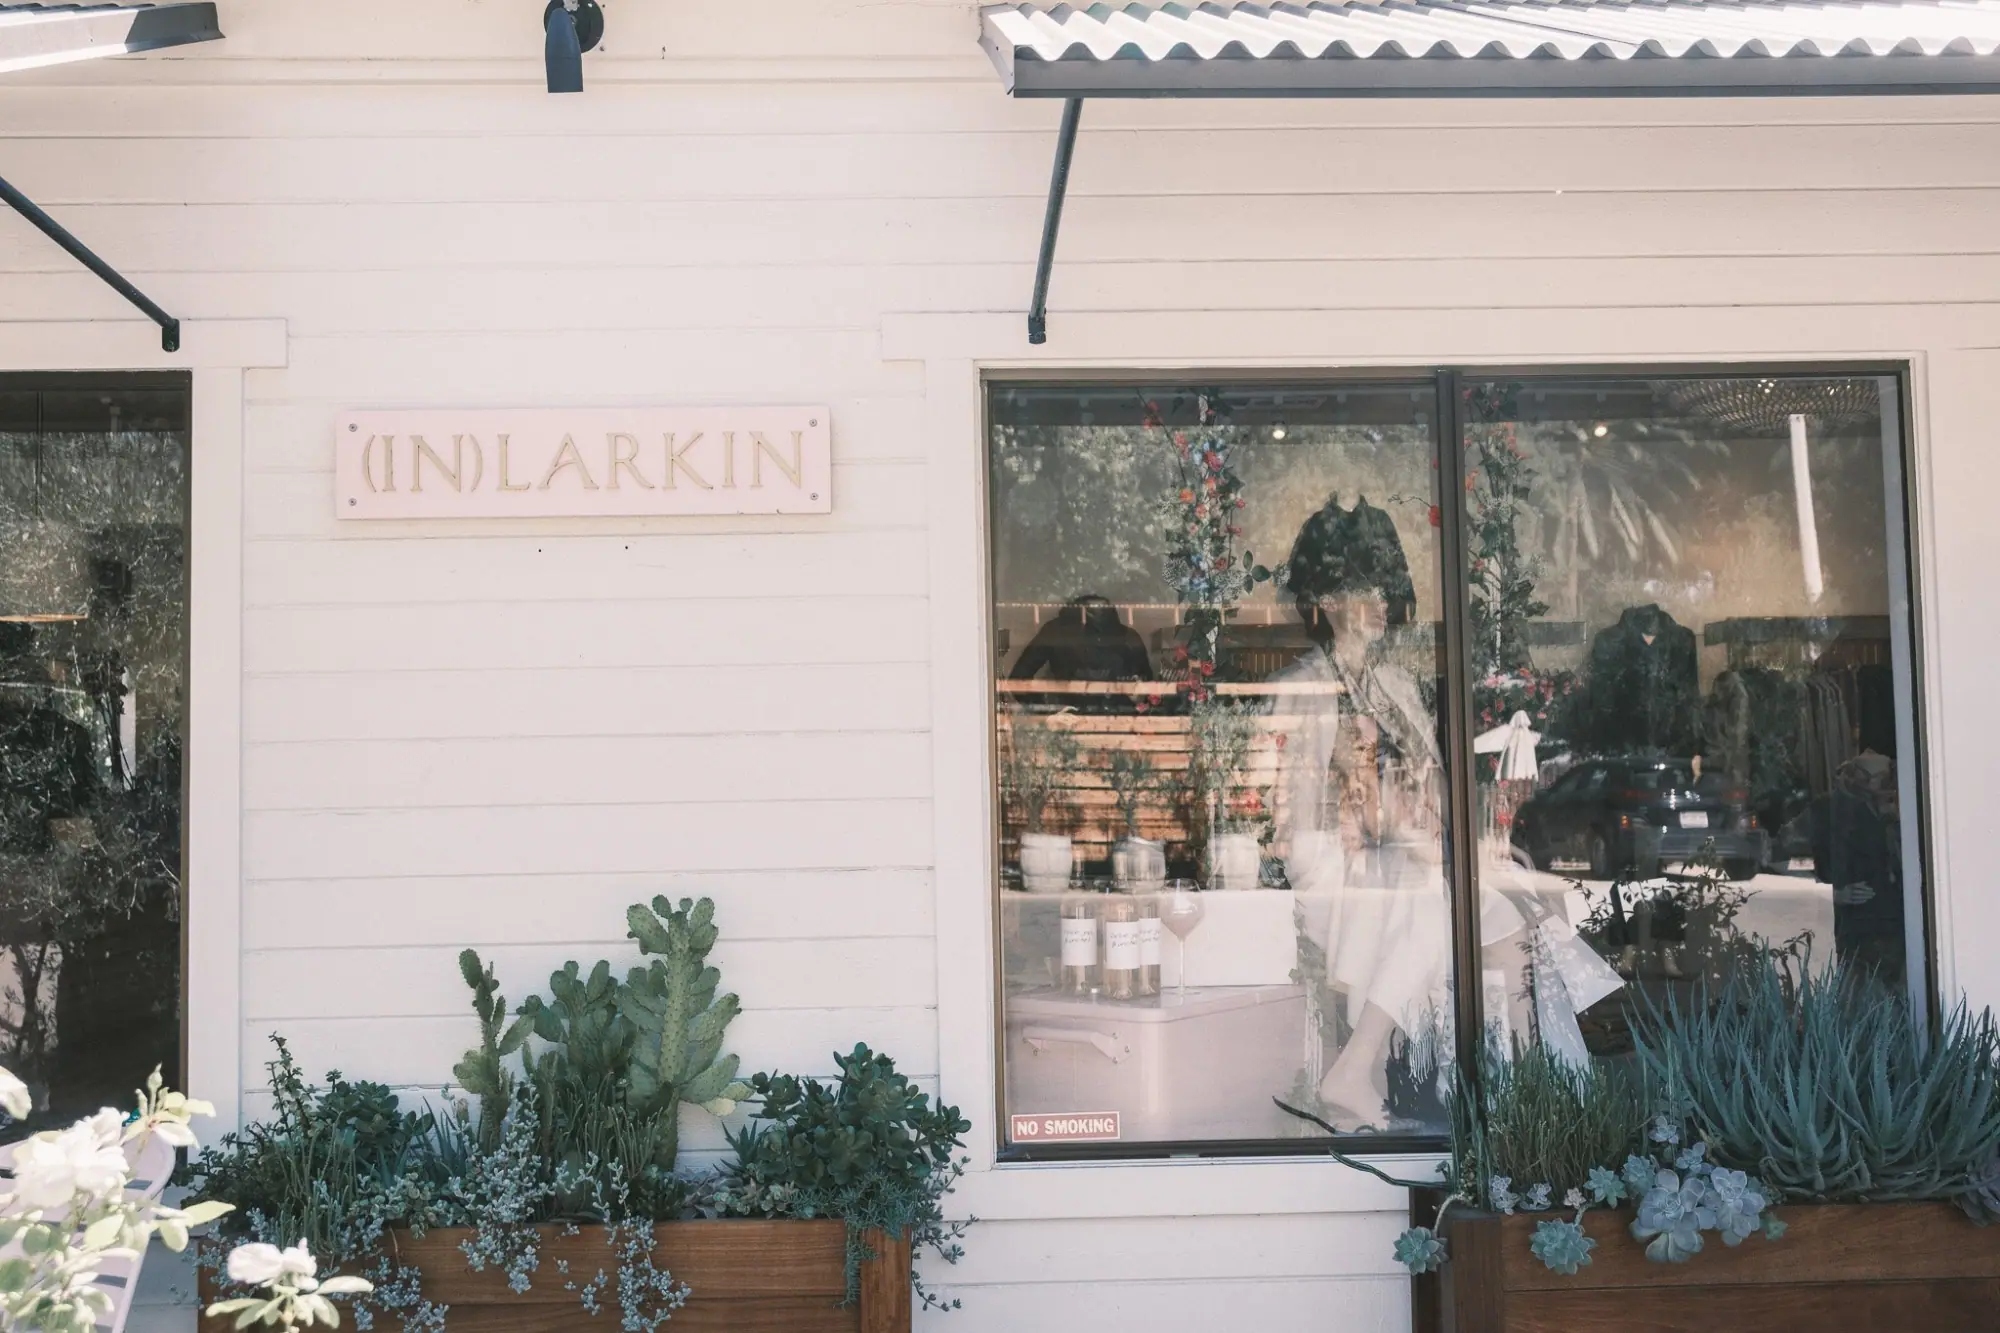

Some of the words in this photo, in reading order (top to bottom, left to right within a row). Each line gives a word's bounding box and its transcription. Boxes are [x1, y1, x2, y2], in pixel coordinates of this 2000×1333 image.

[362, 430, 804, 493] (IN)LARKIN
[1017, 1121, 1039, 1136] NO
[1044, 1118, 1114, 1135] SMOKING
